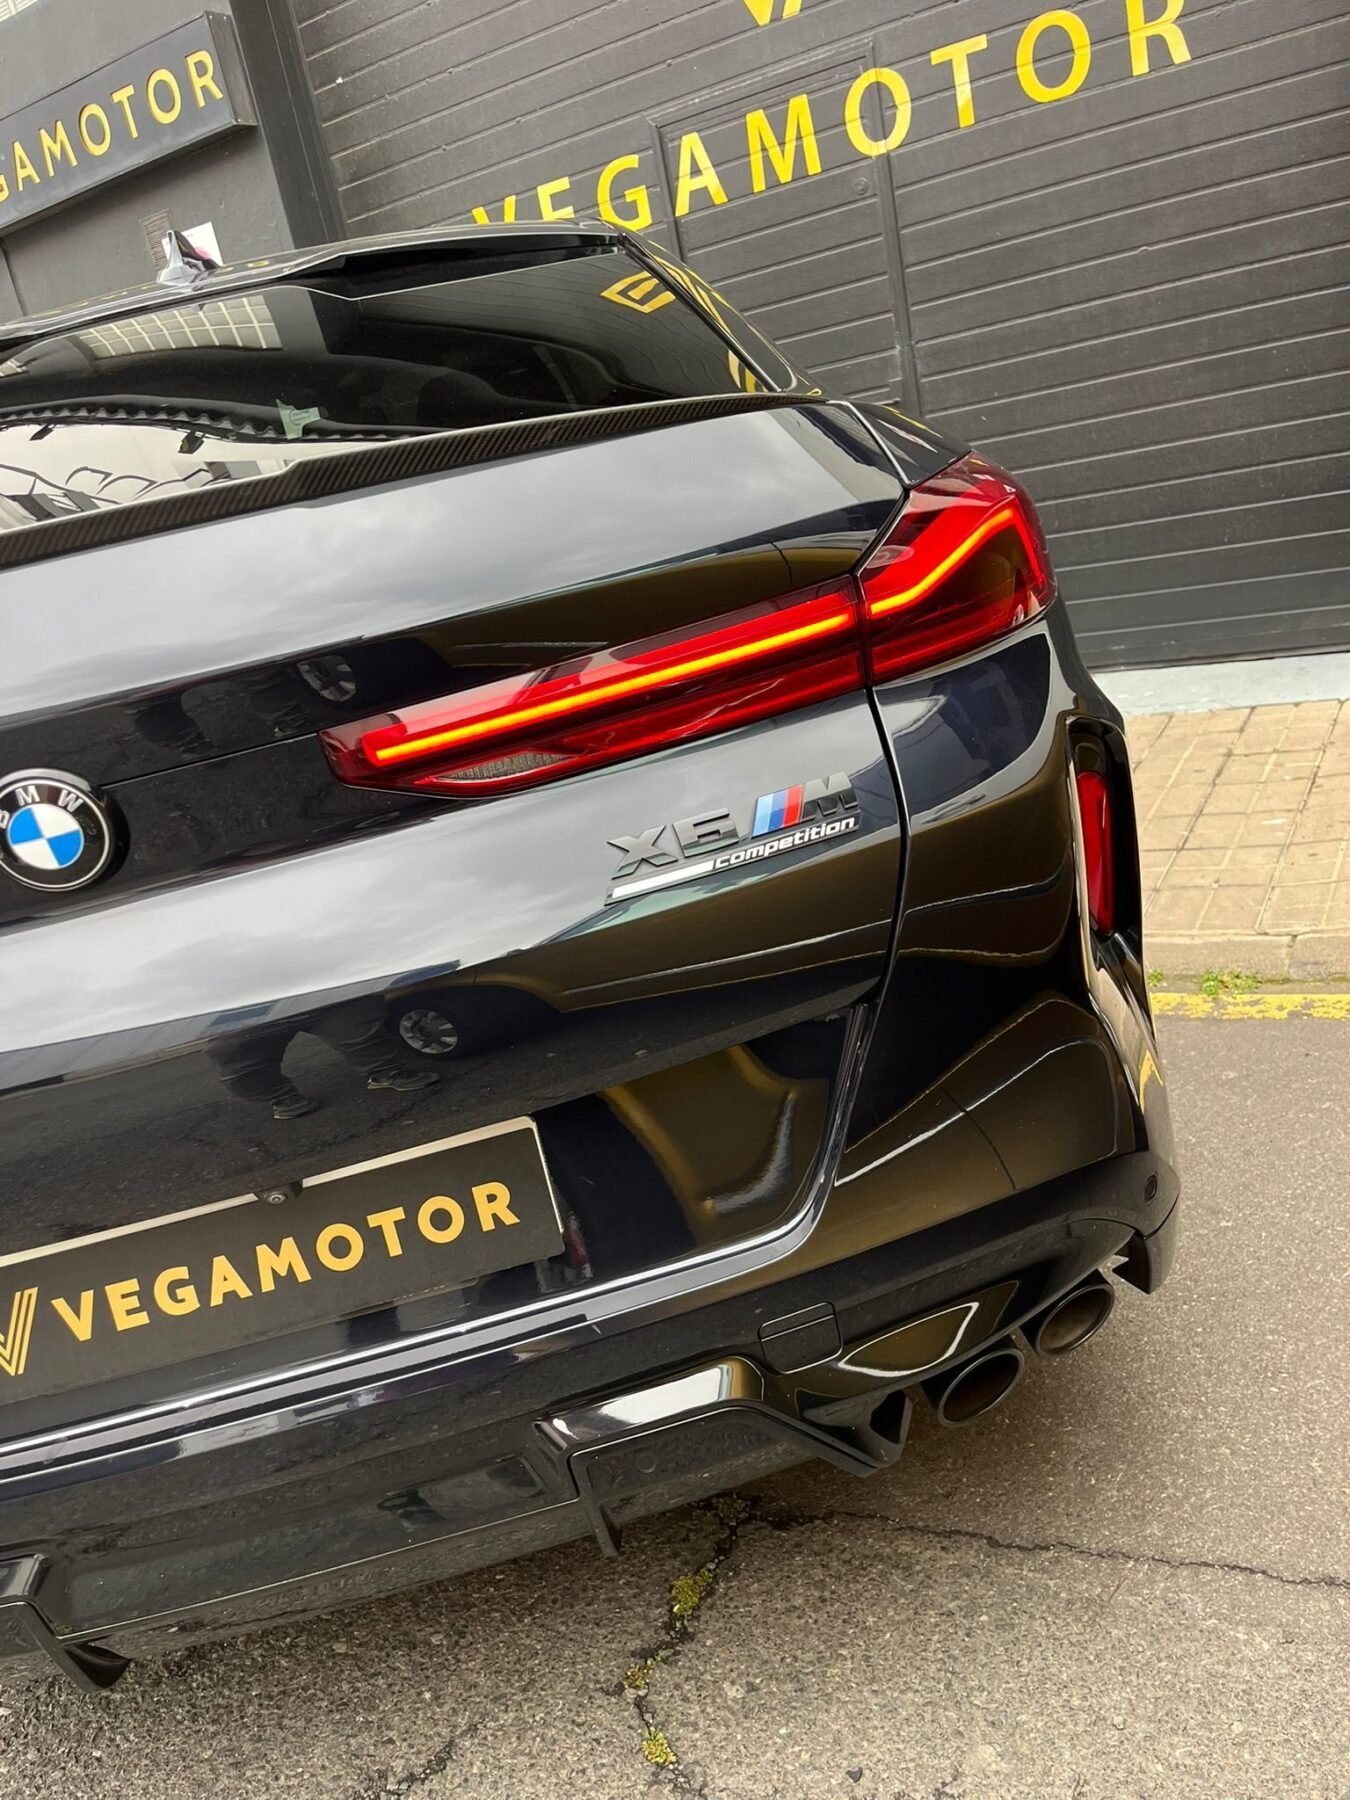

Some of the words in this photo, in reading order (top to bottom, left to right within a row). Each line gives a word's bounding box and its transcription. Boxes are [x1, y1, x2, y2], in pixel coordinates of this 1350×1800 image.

[607, 808, 739, 879] X6
[801, 772, 860, 822] M
[714, 817, 855, 868] competition
[51, 1181, 520, 1342] VEGAMOTOR
